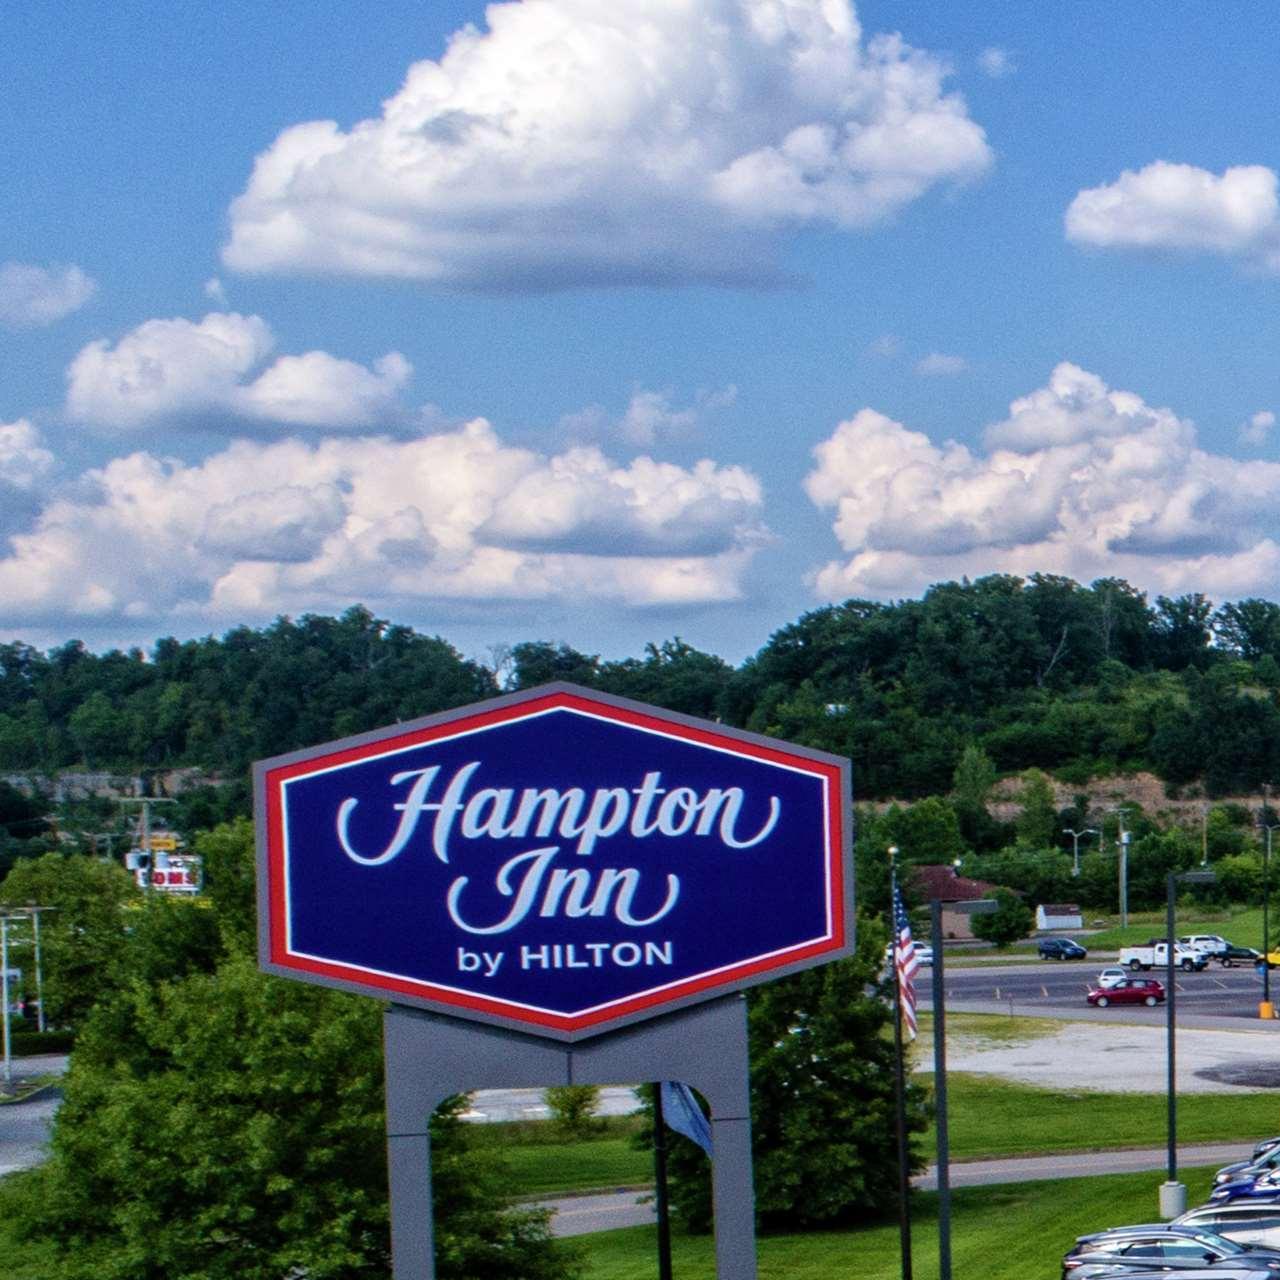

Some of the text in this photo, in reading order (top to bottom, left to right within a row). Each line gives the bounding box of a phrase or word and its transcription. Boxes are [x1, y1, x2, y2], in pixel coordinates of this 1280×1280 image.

[336, 761, 781, 866] Hampton
[446, 846, 681, 935] Inn
[457, 941, 675, 977] by HILTON
